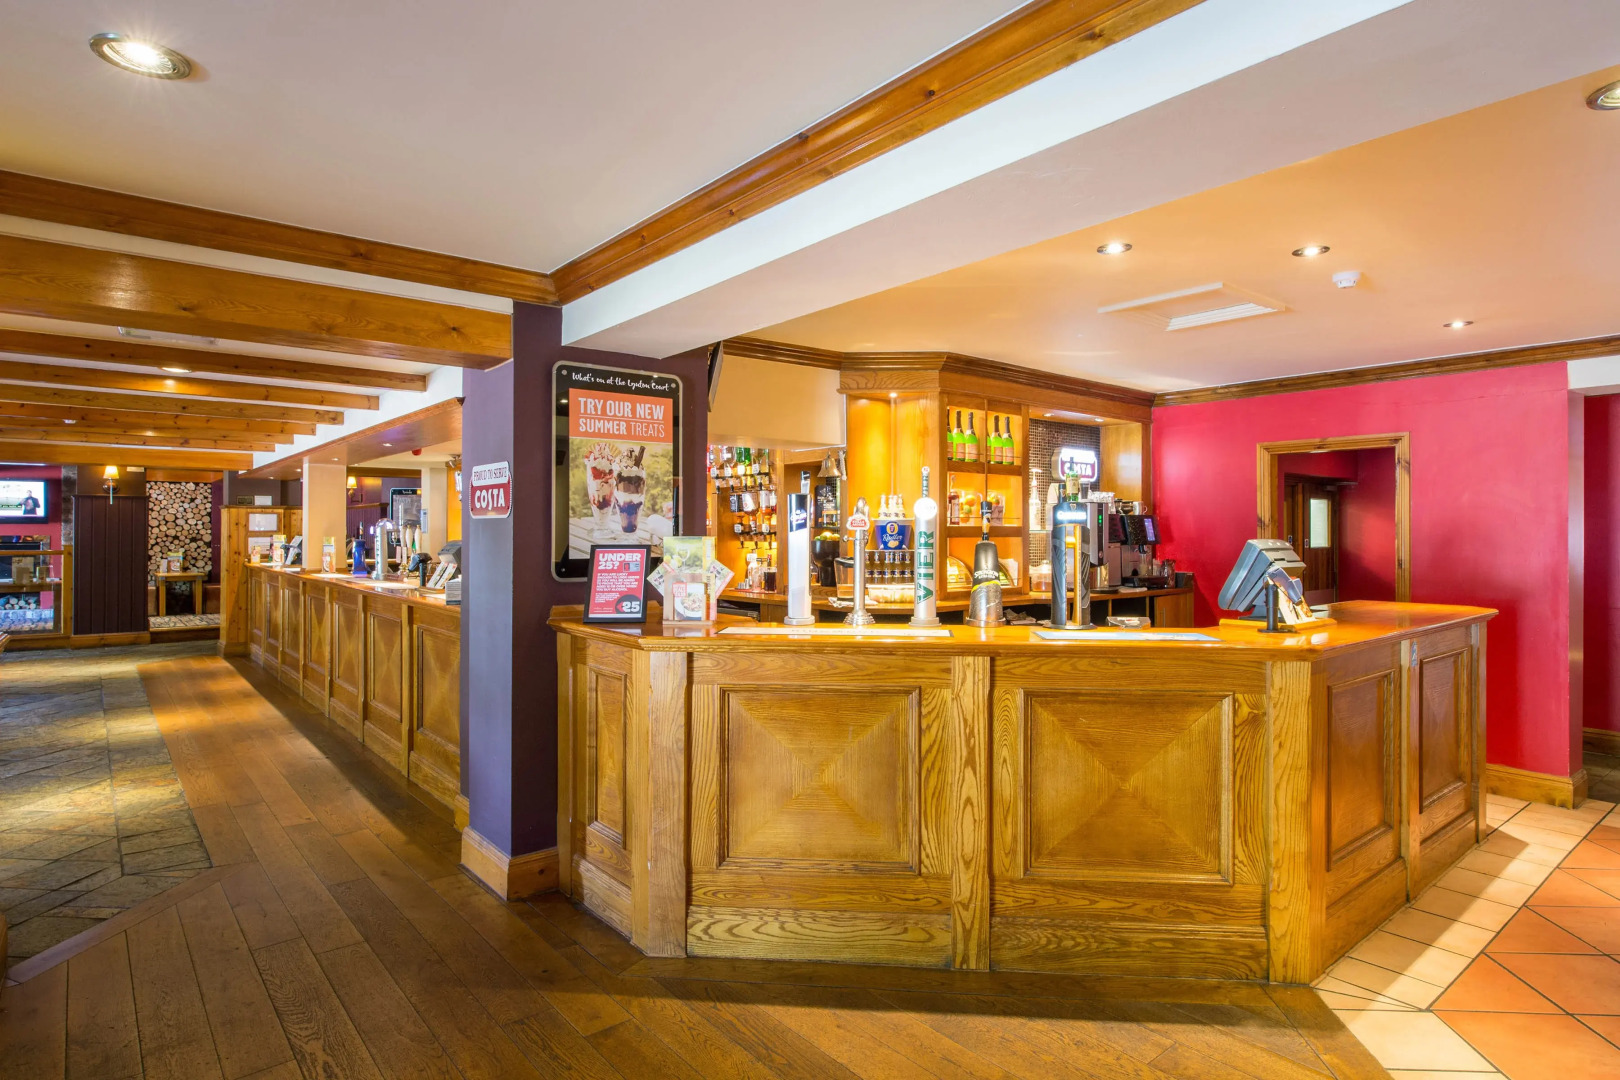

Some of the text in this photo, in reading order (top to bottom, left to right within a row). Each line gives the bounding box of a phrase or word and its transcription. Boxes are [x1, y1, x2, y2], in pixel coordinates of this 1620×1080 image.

[572, 372, 594, 382] What's
[606, 377, 614, 385] at
[651, 382, 670, 391] Court
[578, 397, 664, 420] TRY OUR NEW
[579, 419, 665, 437] SUMMER TREATS
[488, 469, 493, 480] TO
[1064, 462, 1092, 476] CSTA
[475, 488, 505, 510] COSTA
[599, 553, 641, 561] UNDER
[917, 531, 934, 605] VIER
[622, 601, 640, 612] 25
